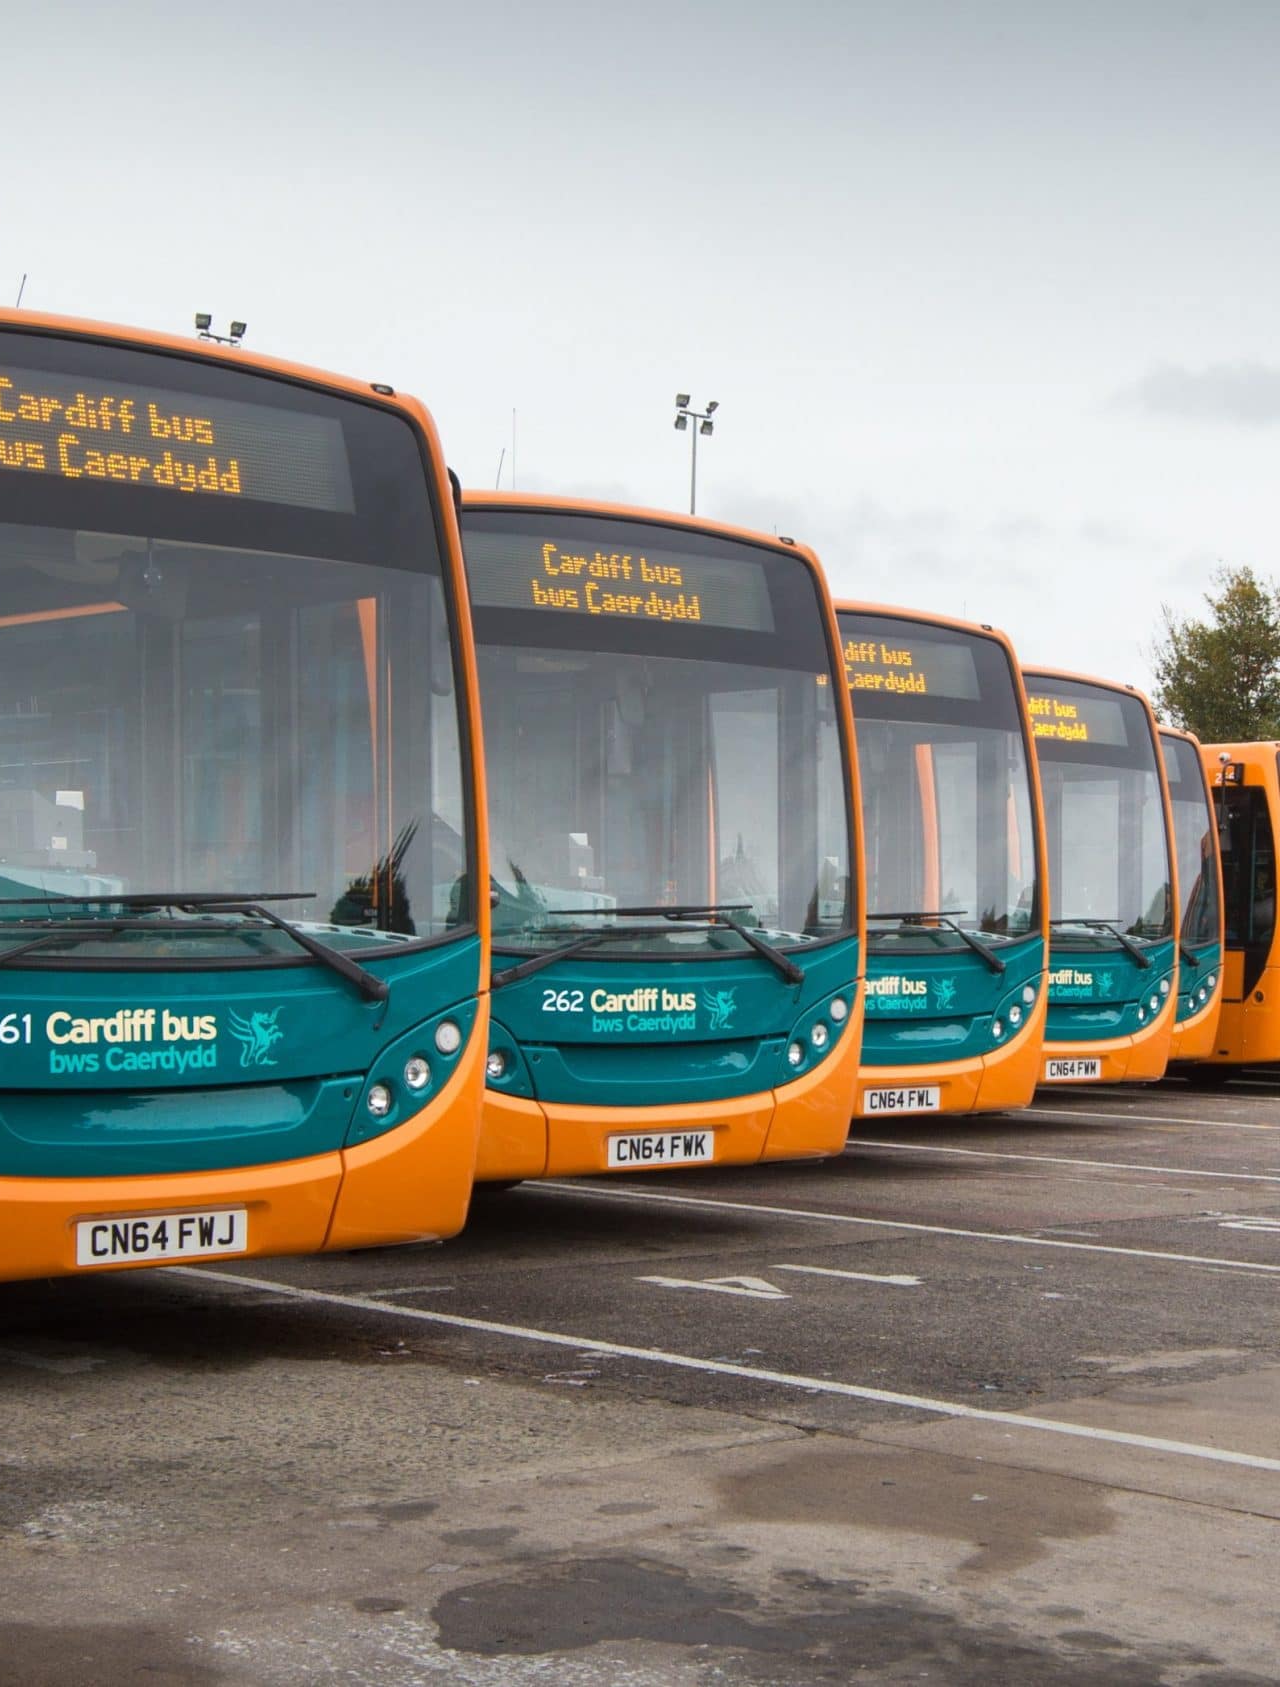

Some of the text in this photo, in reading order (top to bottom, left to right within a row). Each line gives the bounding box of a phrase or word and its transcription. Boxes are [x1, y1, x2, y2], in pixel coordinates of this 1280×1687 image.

[149, 403, 214, 445] bus
[58, 433, 241, 493] Caerdydd
[542, 543, 683, 586] Cardiff bus
[531, 579, 702, 622] bws Caerdydd
[844, 641, 912, 666] diff bus
[1028, 697, 1077, 718] diff bus
[1031, 716, 1088, 741] aerdydd
[863, 976, 927, 995] ardiff bus
[1047, 969, 1093, 985] ardiff bus
[542, 988, 696, 1012] 262 Cardiff bus
[863, 996, 927, 1012] ws Caerdydd
[46, 1009, 156, 1044] Cardiff
[162, 1008, 217, 1041] bus
[593, 1013, 696, 1035] bws Caerdydd
[50, 1044, 217, 1074] bws Caerdydd
[1050, 1061, 1097, 1076] CN64 FWM
[870, 1090, 934, 1109] CN64 FWL
[616, 1134, 706, 1161] CN64 FWK
[91, 1214, 235, 1257] CN64 FWJ
